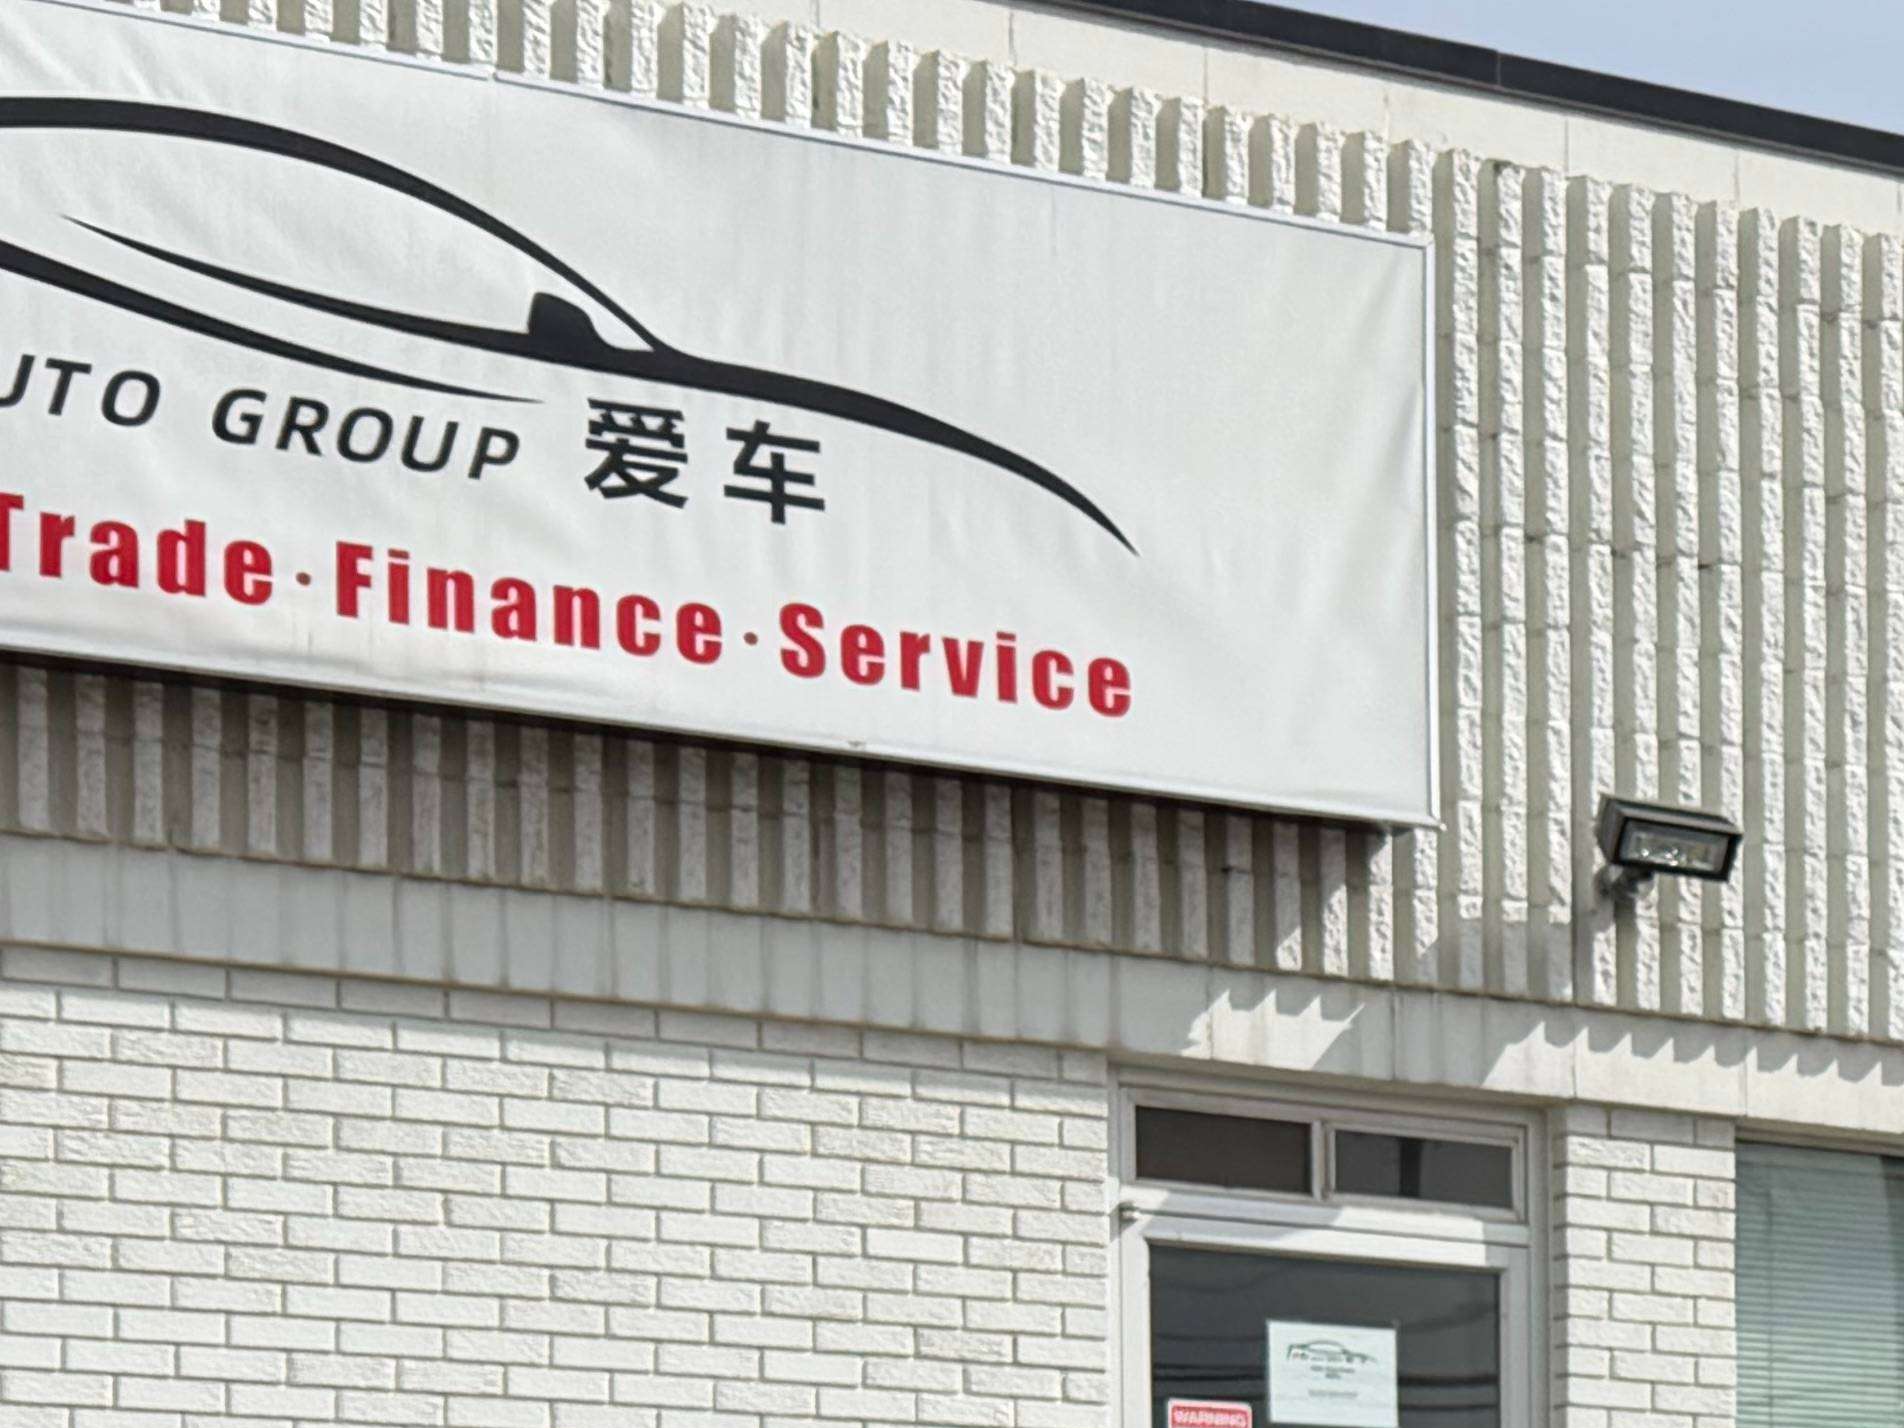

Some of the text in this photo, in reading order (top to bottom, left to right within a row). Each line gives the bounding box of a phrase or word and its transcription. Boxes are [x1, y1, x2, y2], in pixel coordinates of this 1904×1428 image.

[211, 388, 520, 480] GROUP
[584, 397, 826, 524] 爱车
[336, 540, 723, 665] Finance
[779, 602, 1132, 718] Service
